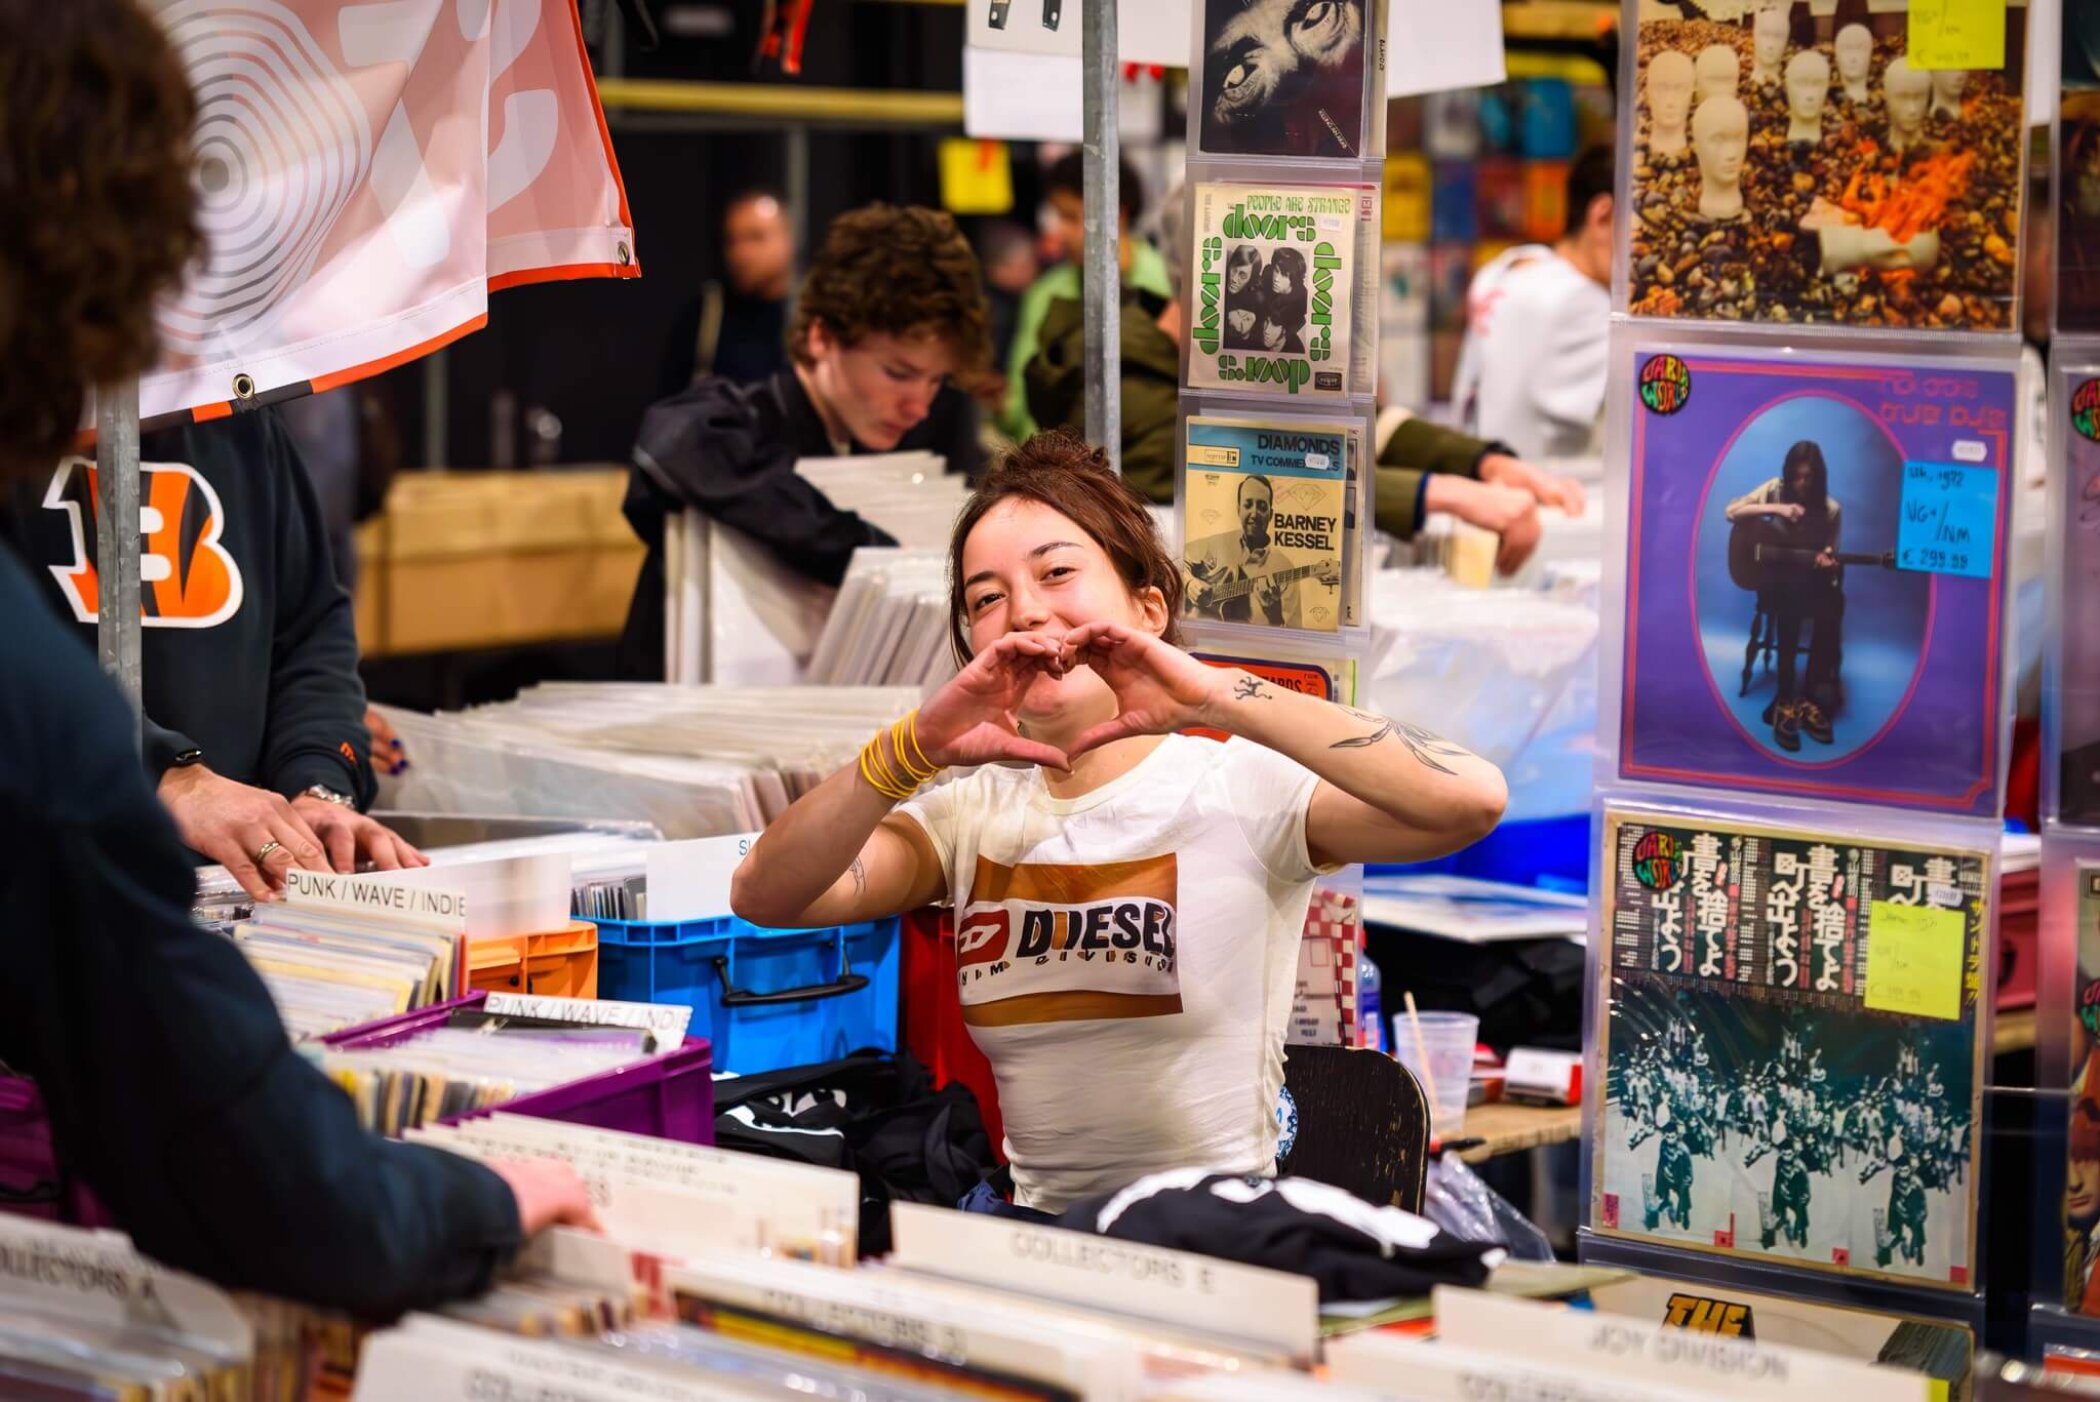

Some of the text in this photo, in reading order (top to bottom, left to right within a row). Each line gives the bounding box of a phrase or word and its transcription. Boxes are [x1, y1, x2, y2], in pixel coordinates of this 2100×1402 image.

[1246, 195, 1282, 212] PEOPLE
[1286, 196, 1304, 213] ARE
[1307, 197, 1351, 215] STRANGE
[1257, 434, 1341, 455] DIAMONDS
[1251, 455, 1265, 465] TV
[1273, 513, 1337, 533] BARNEY
[1273, 532, 1335, 551] KESSEL
[288, 873, 336, 900] PUNK
[352, 881, 405, 909] WAVE
[422, 891, 466, 917] INDIE
[488, 994, 540, 1019] PUNK
[564, 1002, 617, 1027] WAVE
[1010, 1230, 1187, 1288] COLLECTORS
